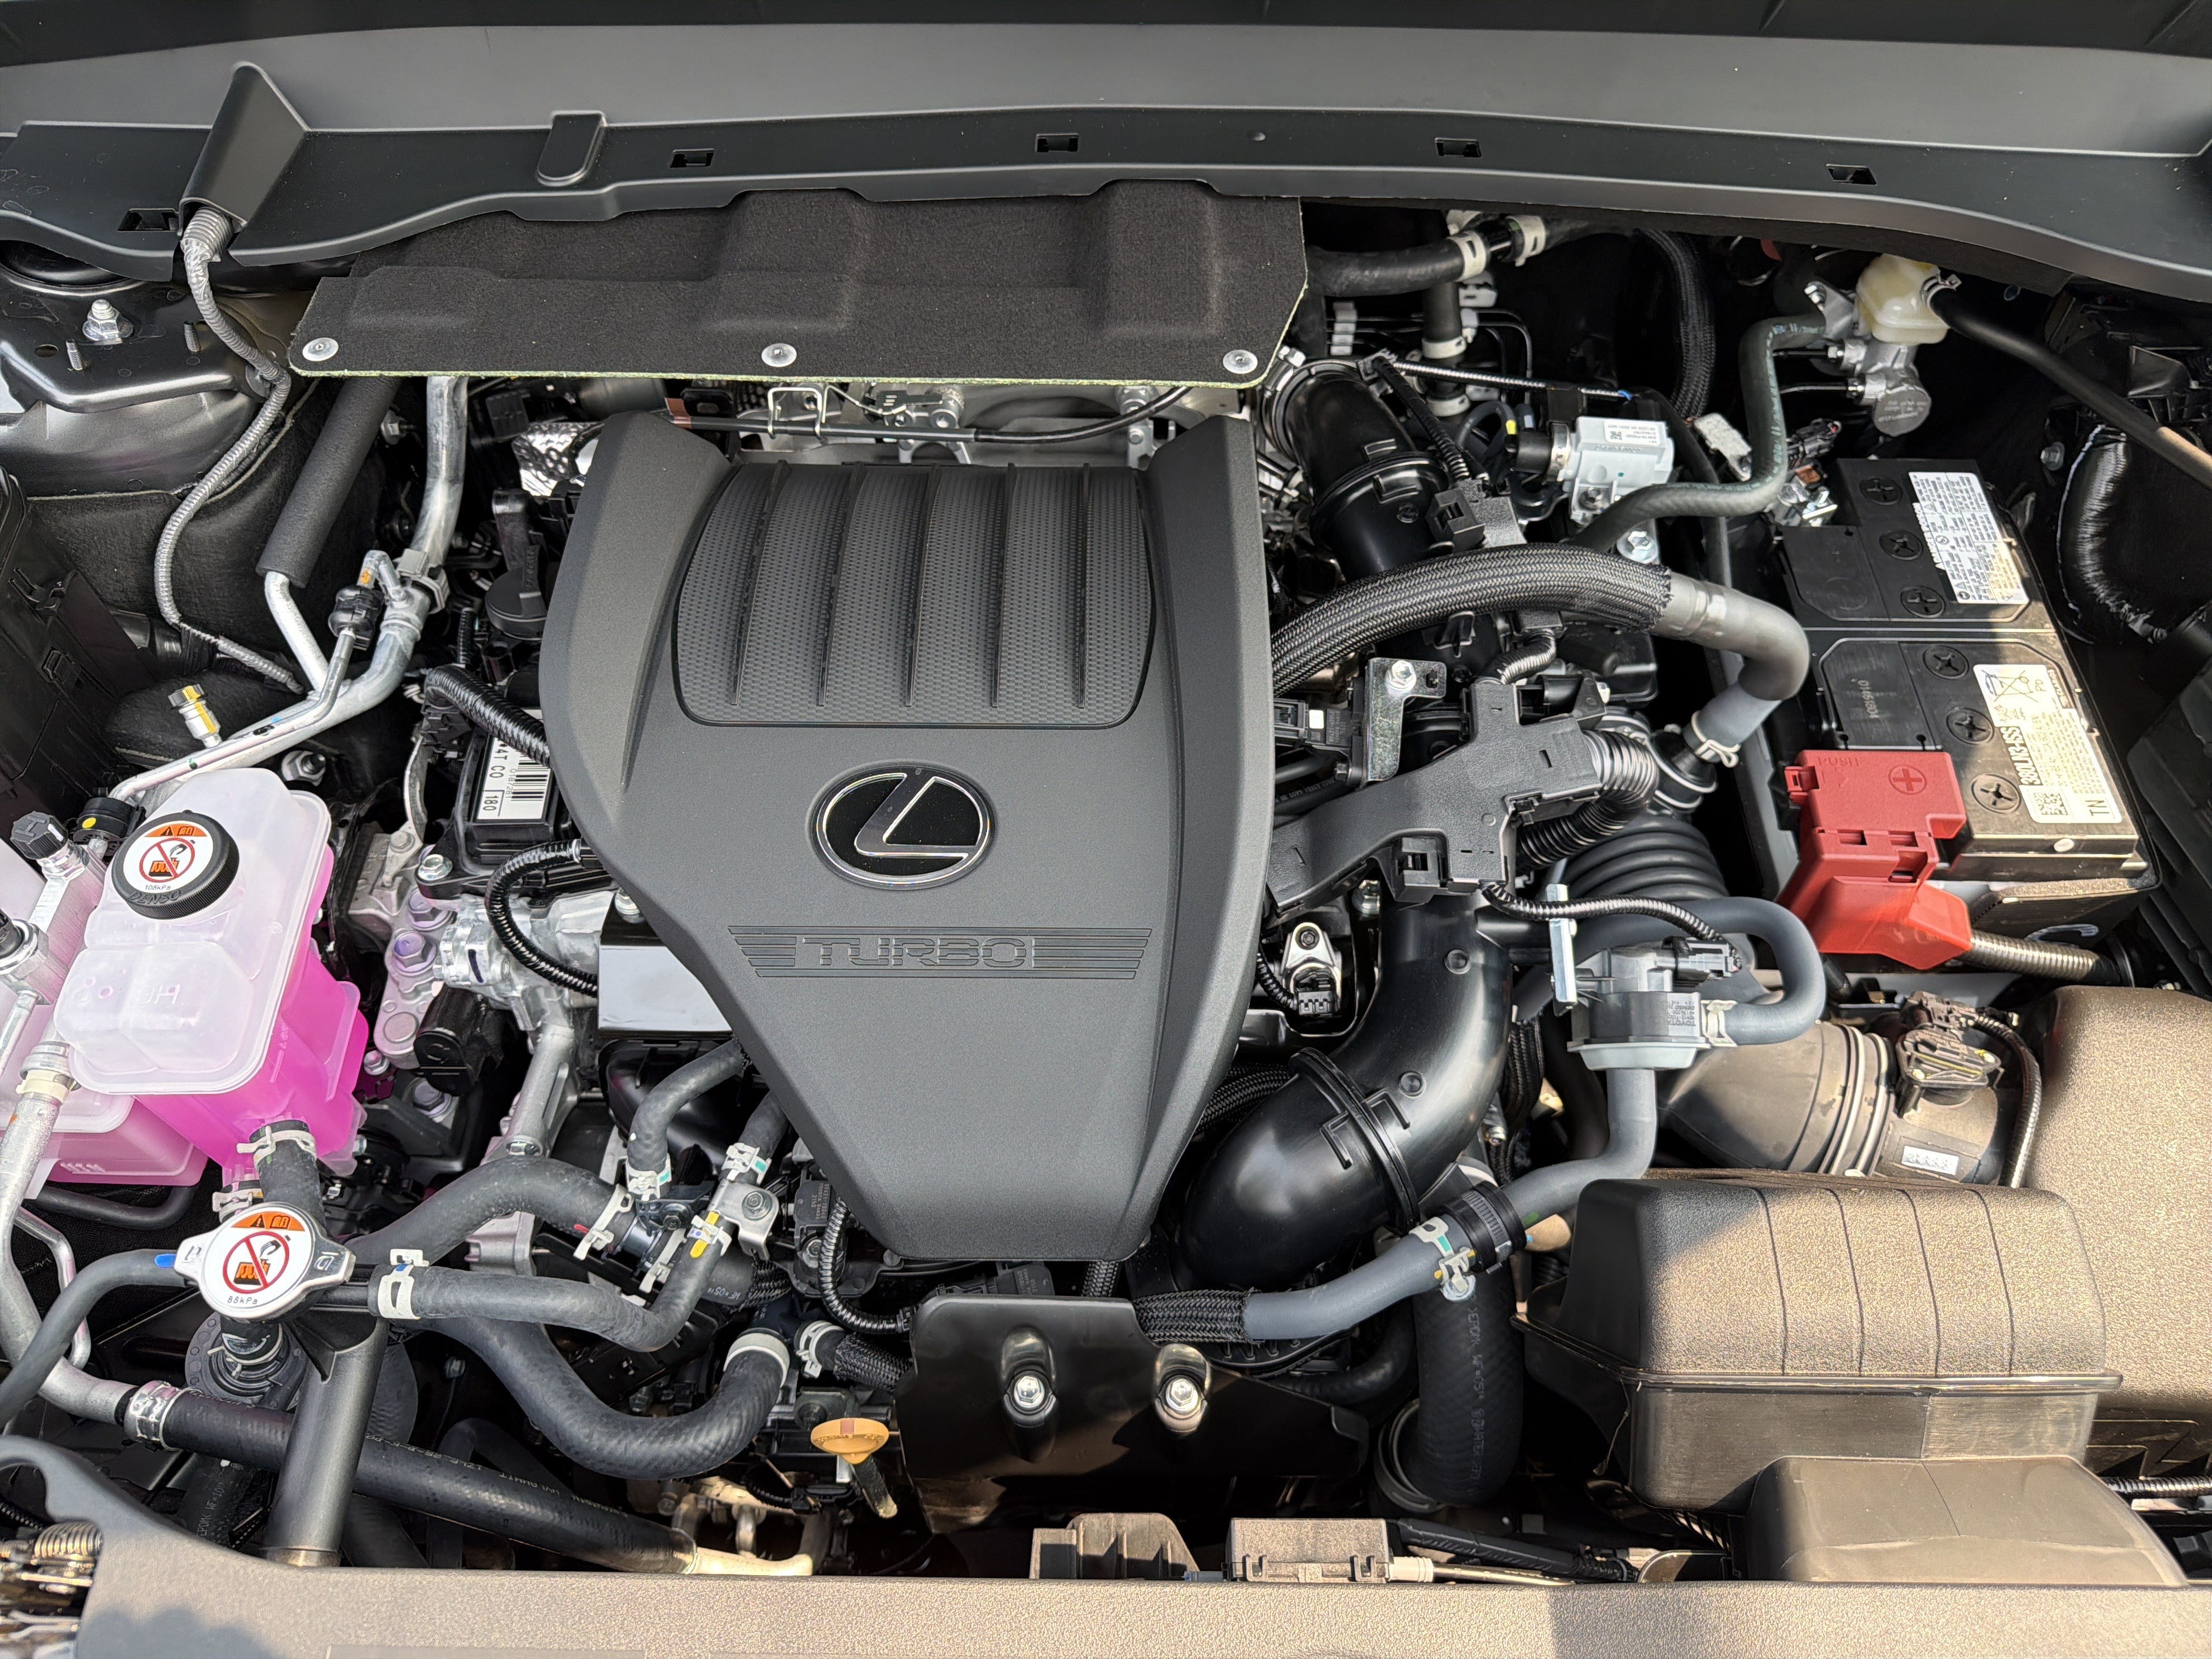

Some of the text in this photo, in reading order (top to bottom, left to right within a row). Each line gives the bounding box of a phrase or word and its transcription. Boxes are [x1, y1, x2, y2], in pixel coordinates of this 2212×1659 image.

[483, 795, 499, 810] 180
[2086, 800, 2109, 816] TN
[129, 890, 182, 904] DENSO
[802, 937, 1028, 967] TURBO
[227, 1295, 258, 1305] 88kPa
